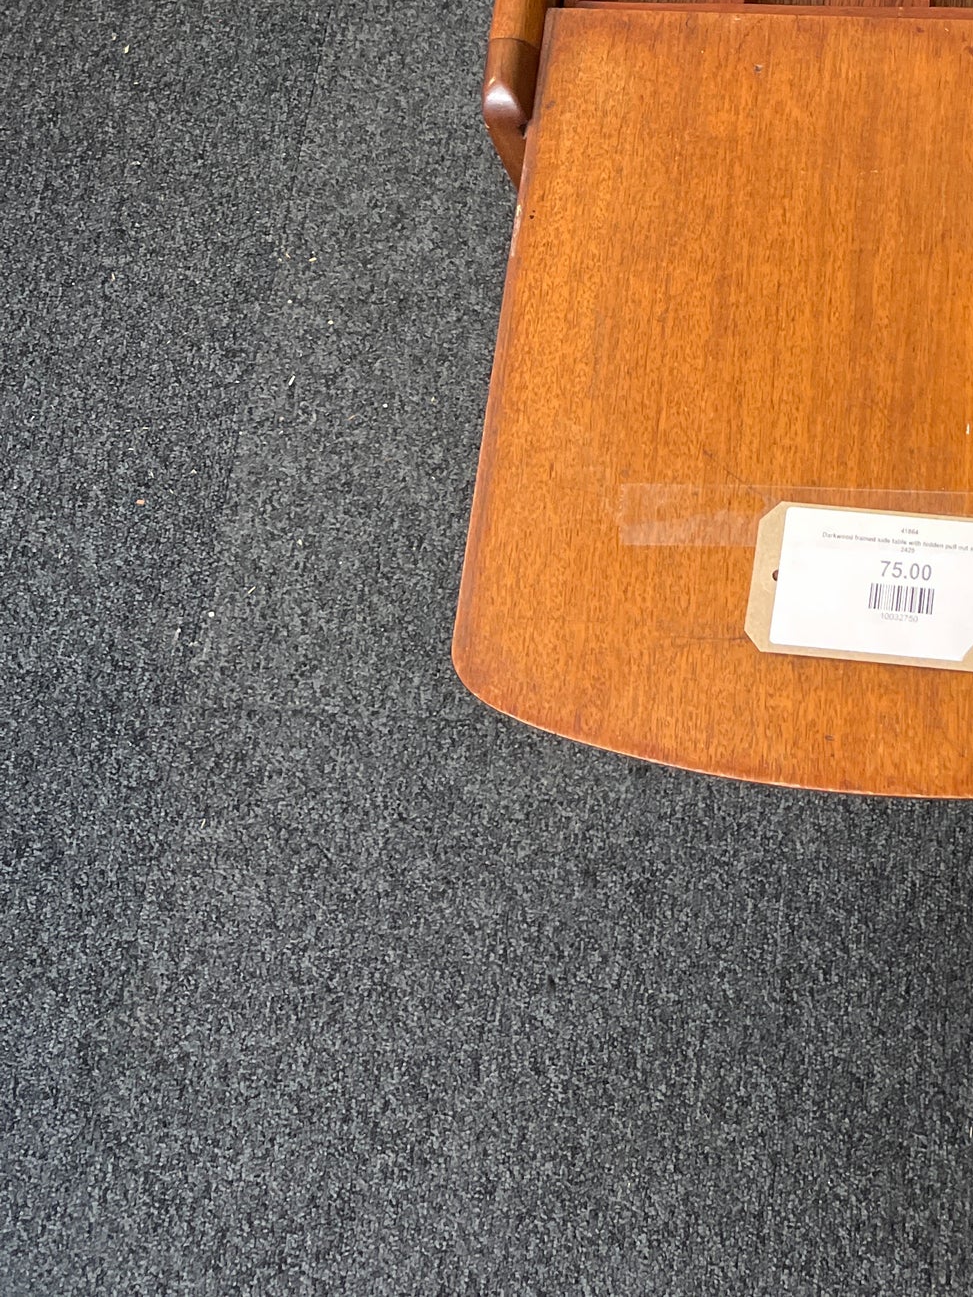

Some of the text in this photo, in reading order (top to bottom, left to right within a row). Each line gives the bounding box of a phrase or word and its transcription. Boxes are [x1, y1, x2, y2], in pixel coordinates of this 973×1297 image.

[822, 531, 854, 540] Darkwood
[945, 543, 957, 551] pull
[880, 560, 932, 581] 75.00
[880, 612, 919, 623] 10032750
